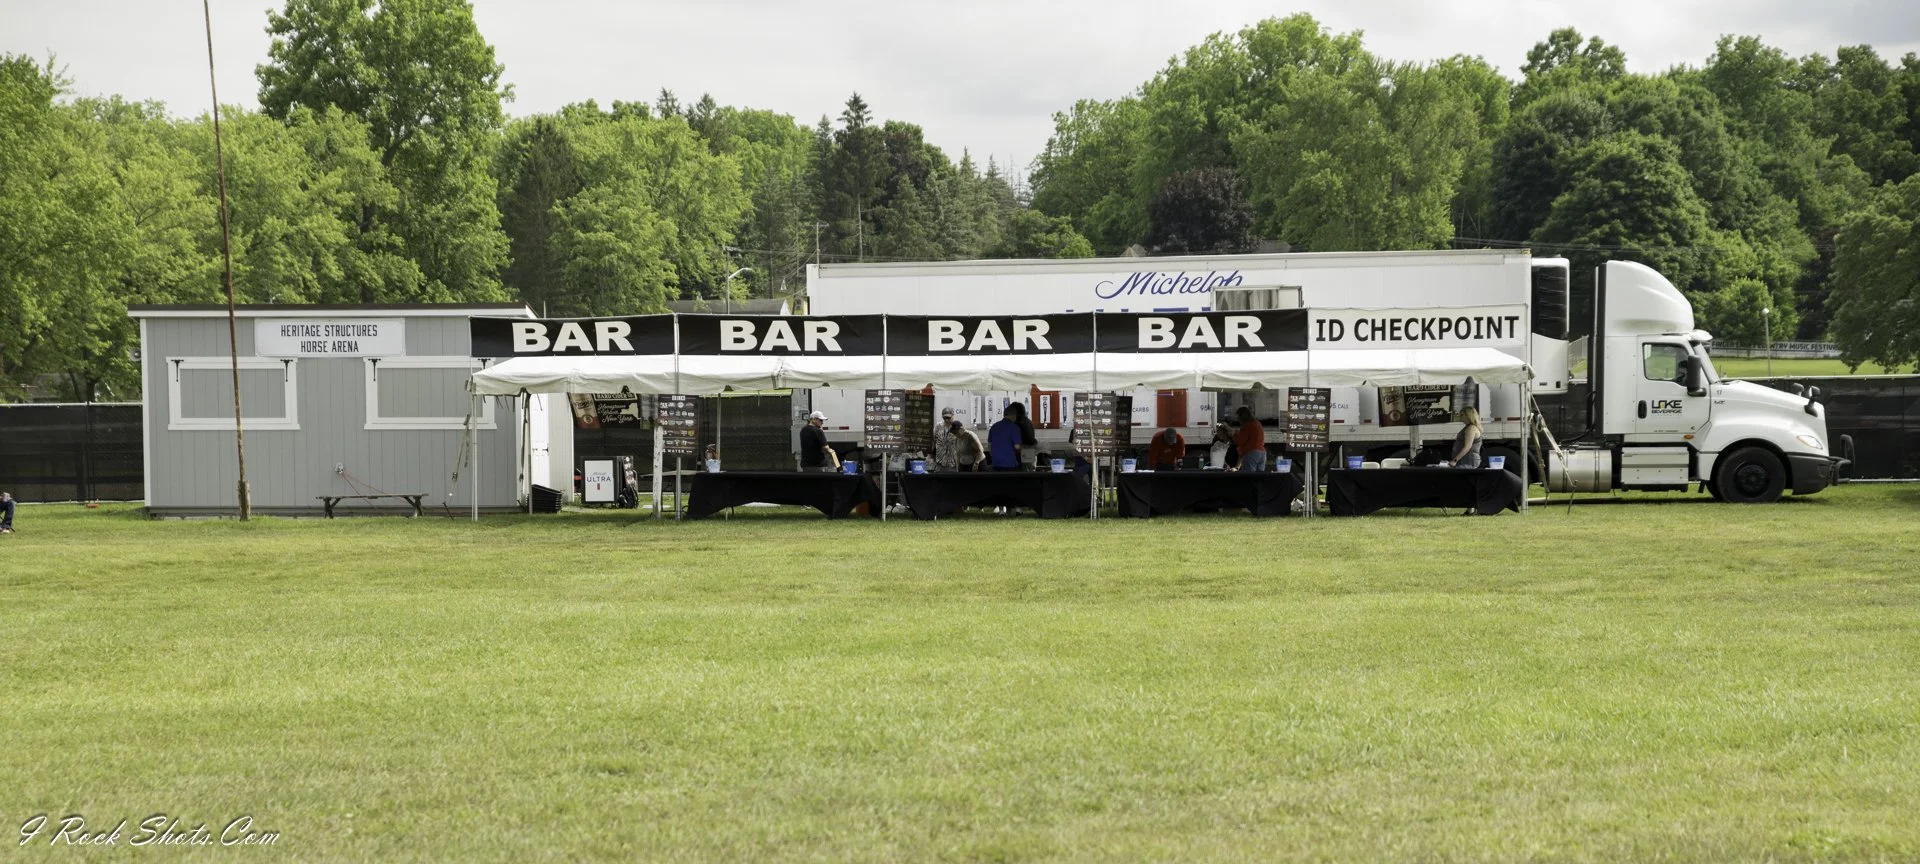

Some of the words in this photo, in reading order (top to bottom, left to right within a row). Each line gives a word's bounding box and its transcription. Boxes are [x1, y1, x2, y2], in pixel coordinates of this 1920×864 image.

[1095, 270, 1243, 299] Michelob
[281, 325, 321, 337] HERITAGE
[325, 325, 378, 337] STRUCTURES
[512, 321, 634, 352] BAR
[720, 320, 842, 351] BAR
[928, 319, 1053, 351] BAR
[1138, 315, 1265, 349] BAR
[1316, 318, 1344, 341] ID
[1354, 316, 1519, 341] CHECKPOINT
[301, 341, 328, 352] HORSE
[332, 341, 359, 352] ARENA
[1410, 410, 1427, 419] New
[1427, 410, 1443, 419] York
[1652, 400, 1682, 408] LAKE
[602, 414, 617, 423] New
[618, 414, 633, 424] York
